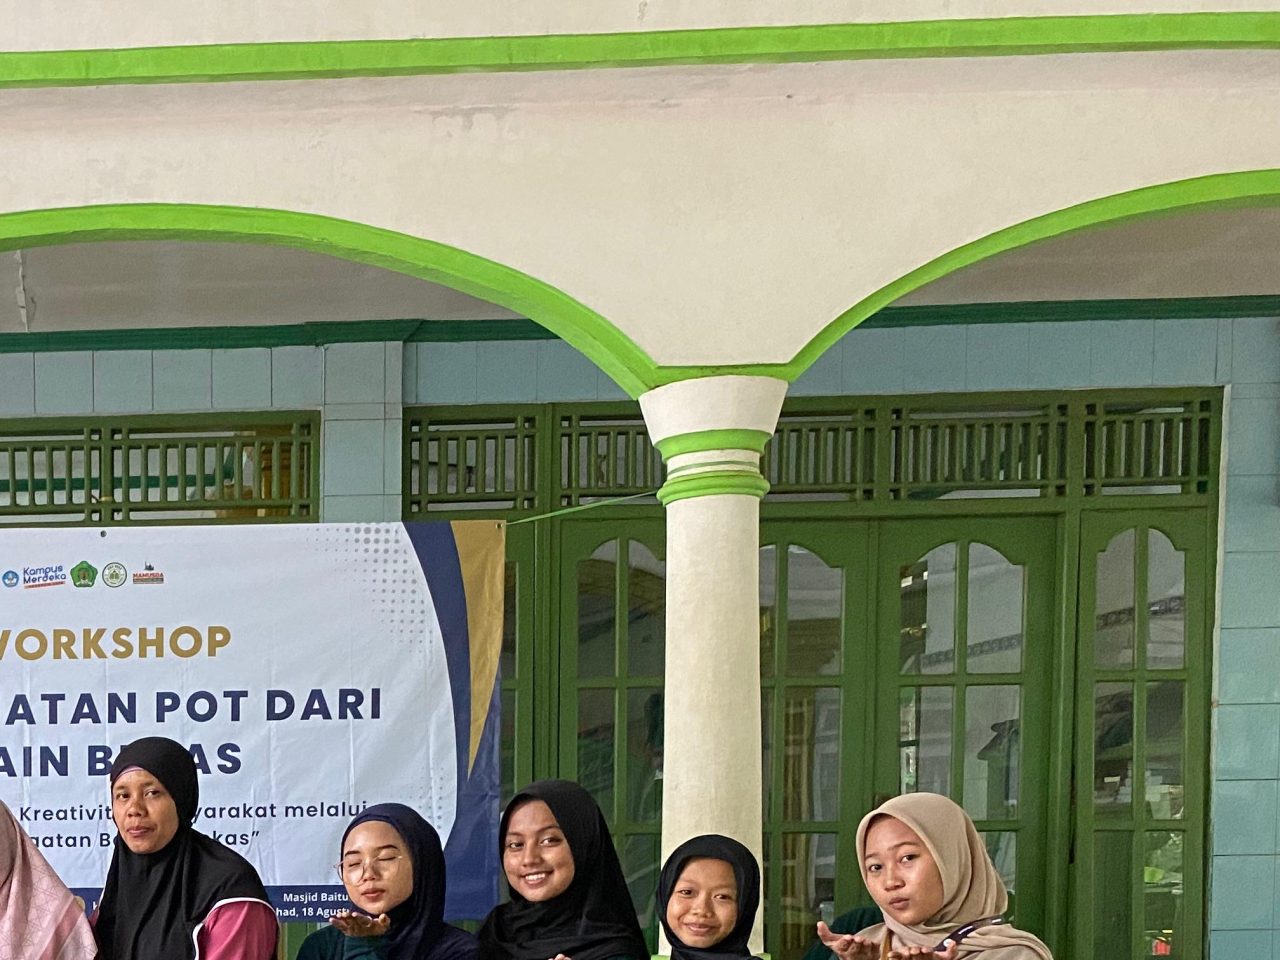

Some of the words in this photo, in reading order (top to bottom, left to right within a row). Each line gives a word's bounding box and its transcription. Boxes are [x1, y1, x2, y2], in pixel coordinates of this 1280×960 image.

[23, 565, 63, 576] Kampus
[23, 573, 67, 584] Merdeka
[156, 690, 248, 723] POT
[266, 687, 381, 721] DARI
[87, 742, 242, 776] BAS
[20, 804, 113, 822] Kreativit
[193, 803, 277, 824] yarakat
[284, 800, 367, 819] melalui
[283, 892, 318, 904] Masjid
[320, 892, 349, 902] Baitu
[276, 907, 299, 918] had,
[302, 907, 314, 917] 18
